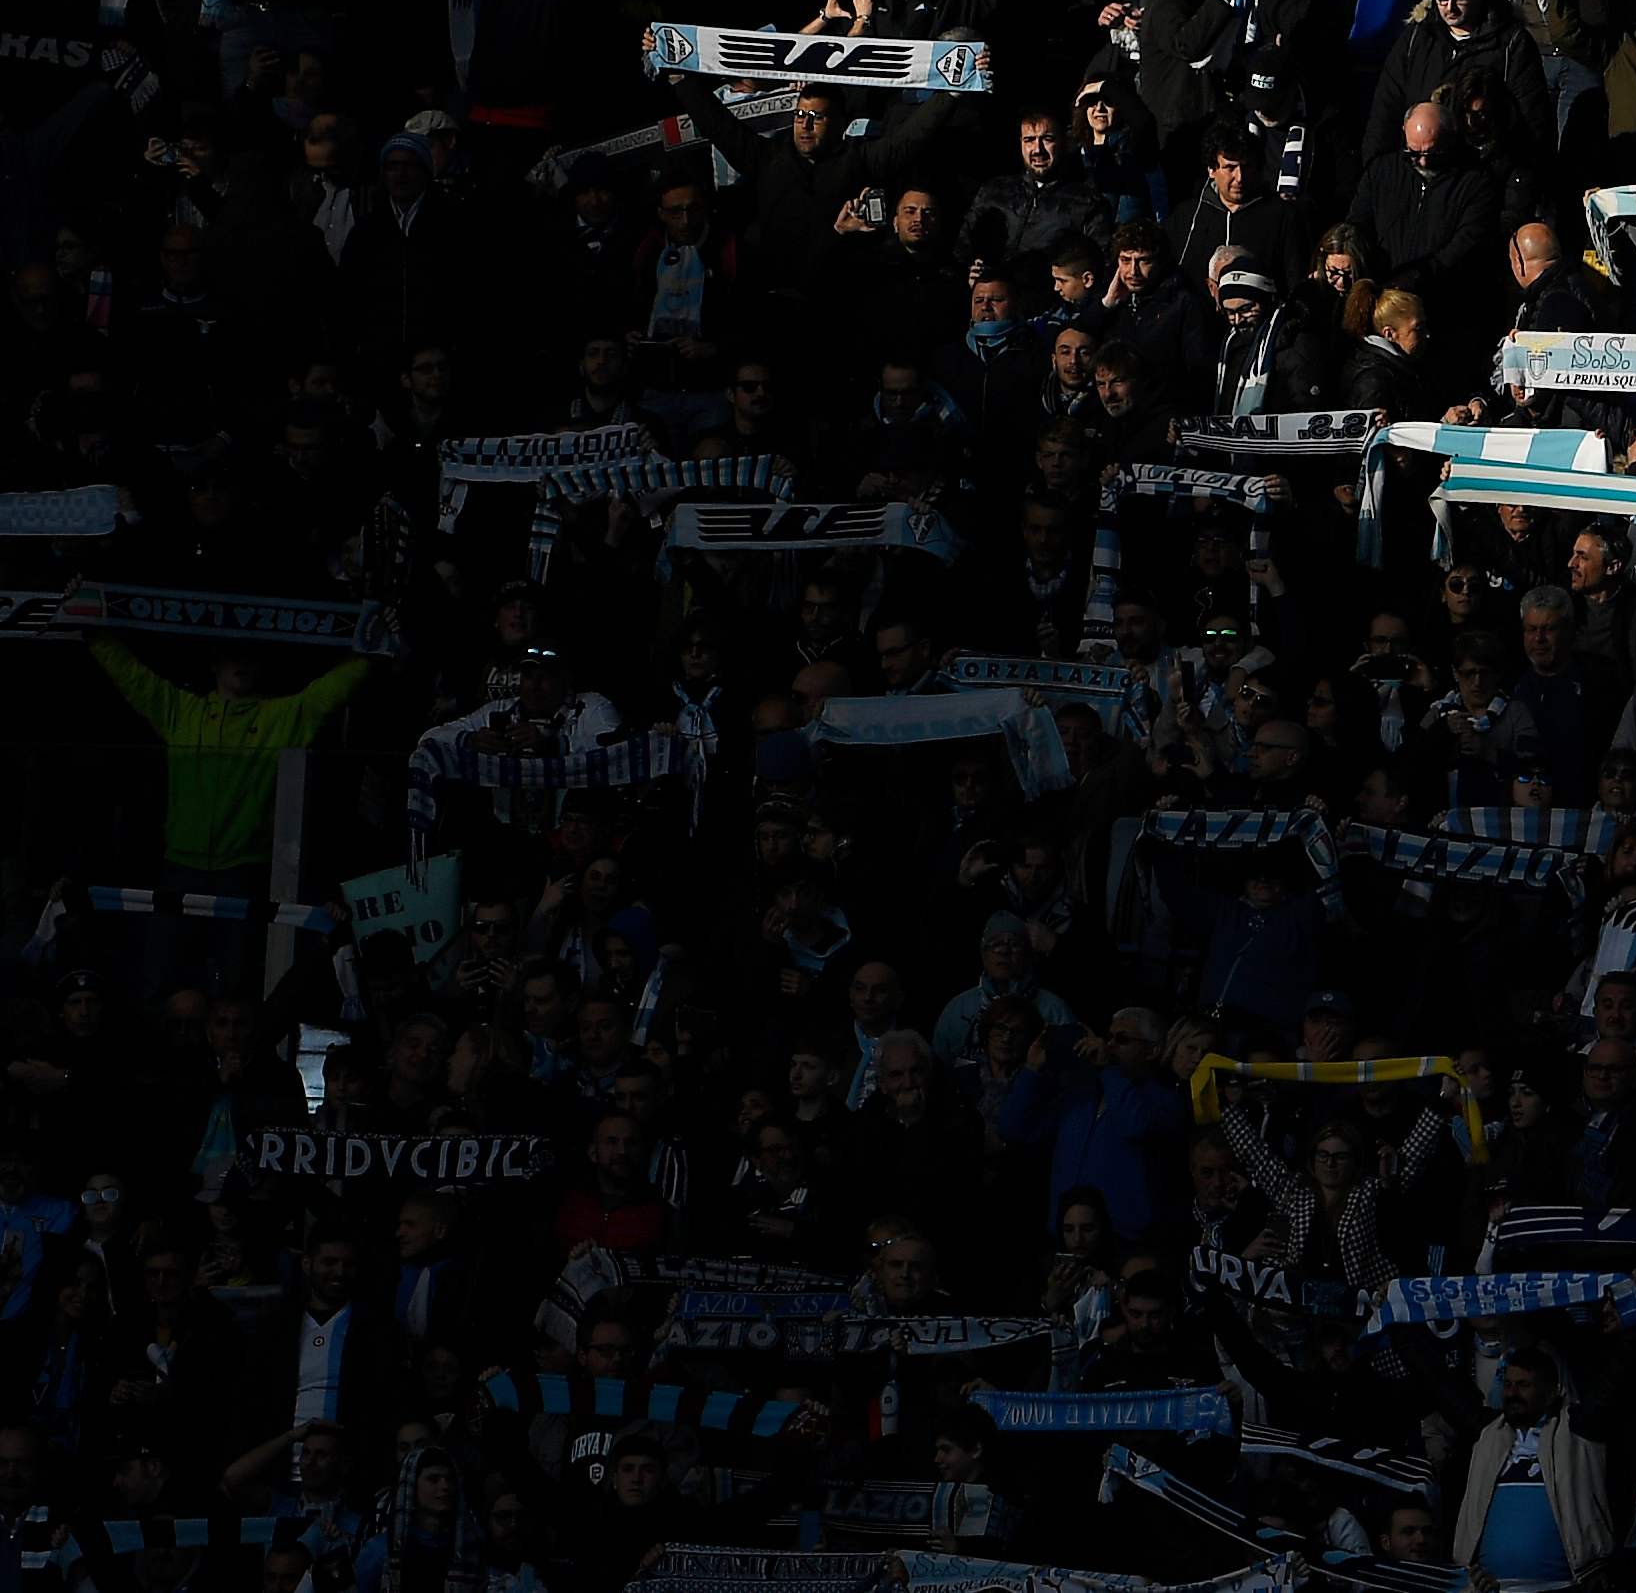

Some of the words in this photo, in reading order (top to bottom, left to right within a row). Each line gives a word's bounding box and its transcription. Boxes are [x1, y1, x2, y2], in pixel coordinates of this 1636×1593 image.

[1569, 335, 1630, 371] S.S.
[1554, 372, 1573, 387] LA
[1574, 373, 1613, 388] PRIMA
[126, 595, 225, 626] LAZIO
[231, 601, 337, 636] FORZA
